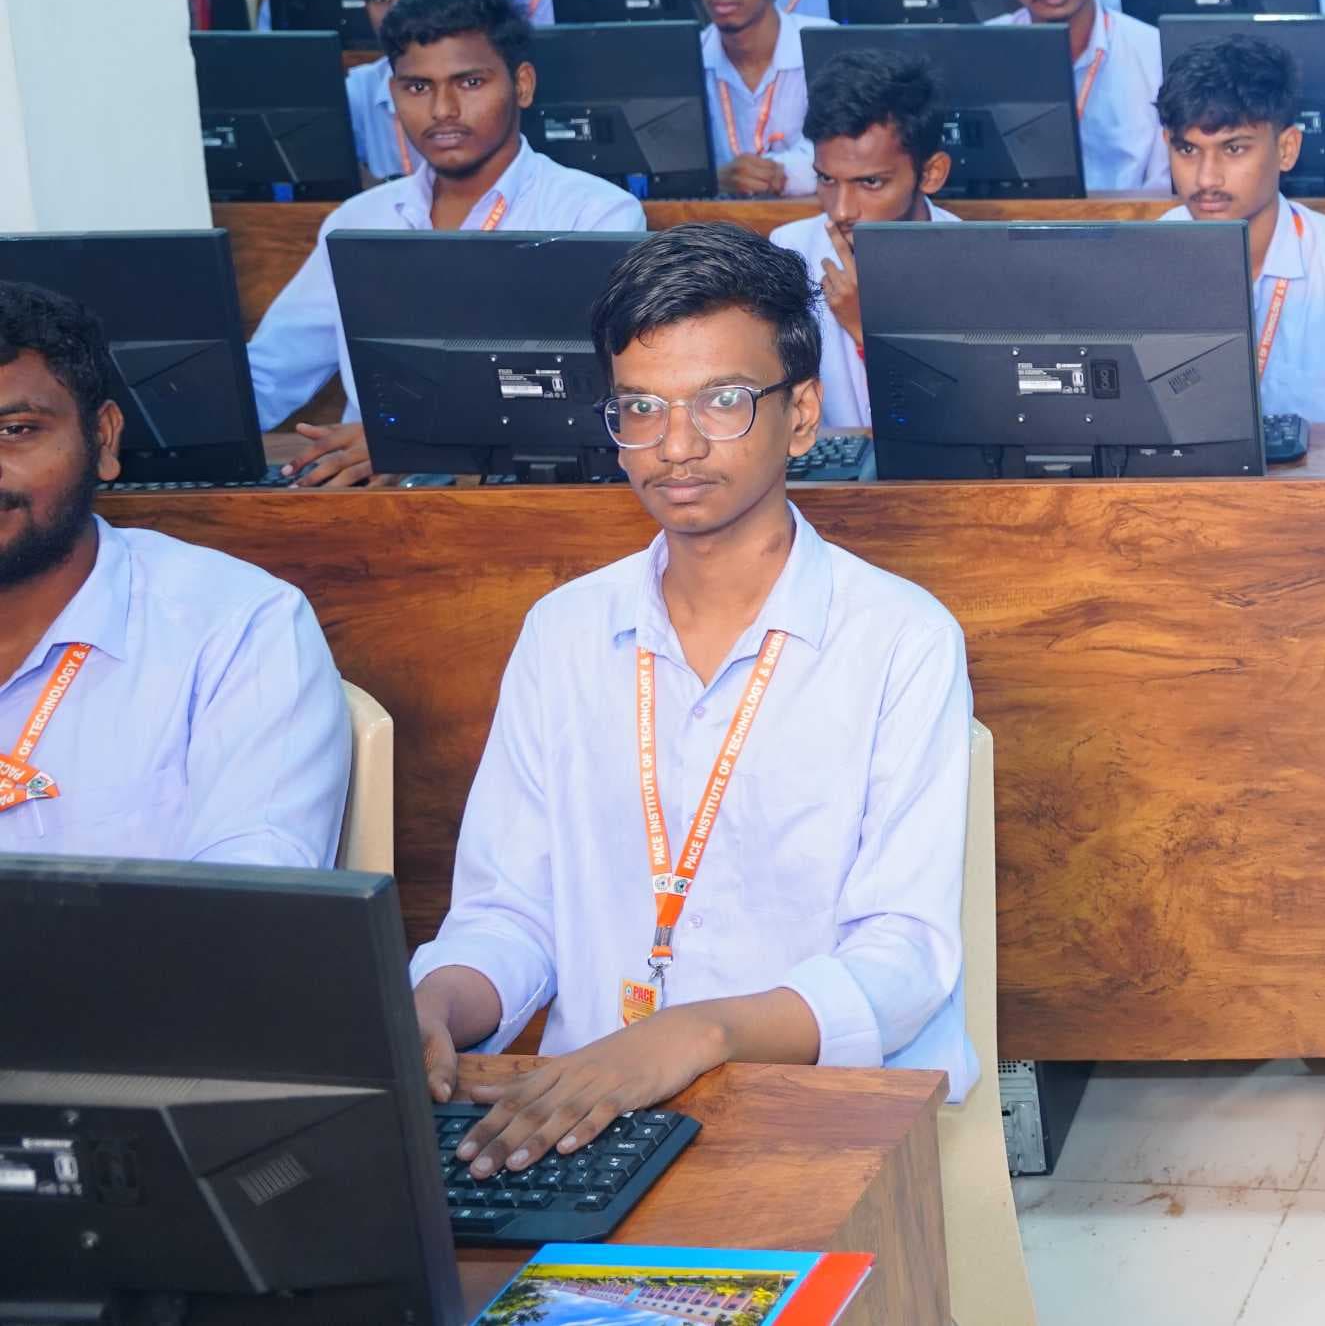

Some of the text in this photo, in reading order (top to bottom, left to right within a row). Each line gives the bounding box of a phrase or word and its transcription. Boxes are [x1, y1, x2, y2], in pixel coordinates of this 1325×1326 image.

[640, 657, 651, 666] &
[18, 737, 34, 756] OF
[27, 659, 80, 737] TECHNOLOGY
[72, 650, 86, 659] &
[640, 670, 653, 751] TECHNOLOGY
[641, 753, 653, 769] OF
[683, 839, 704, 870] PACE
[694, 776, 727, 839] INSTITUTE
[718, 757, 732, 776] OF
[725, 677, 765, 756] TECHNOLOGY
[758, 667, 770, 678] &
[643, 770, 661, 834] INSTITUTE
[652, 835, 666, 867] PACE
[633, 985, 656, 1003] PACE
